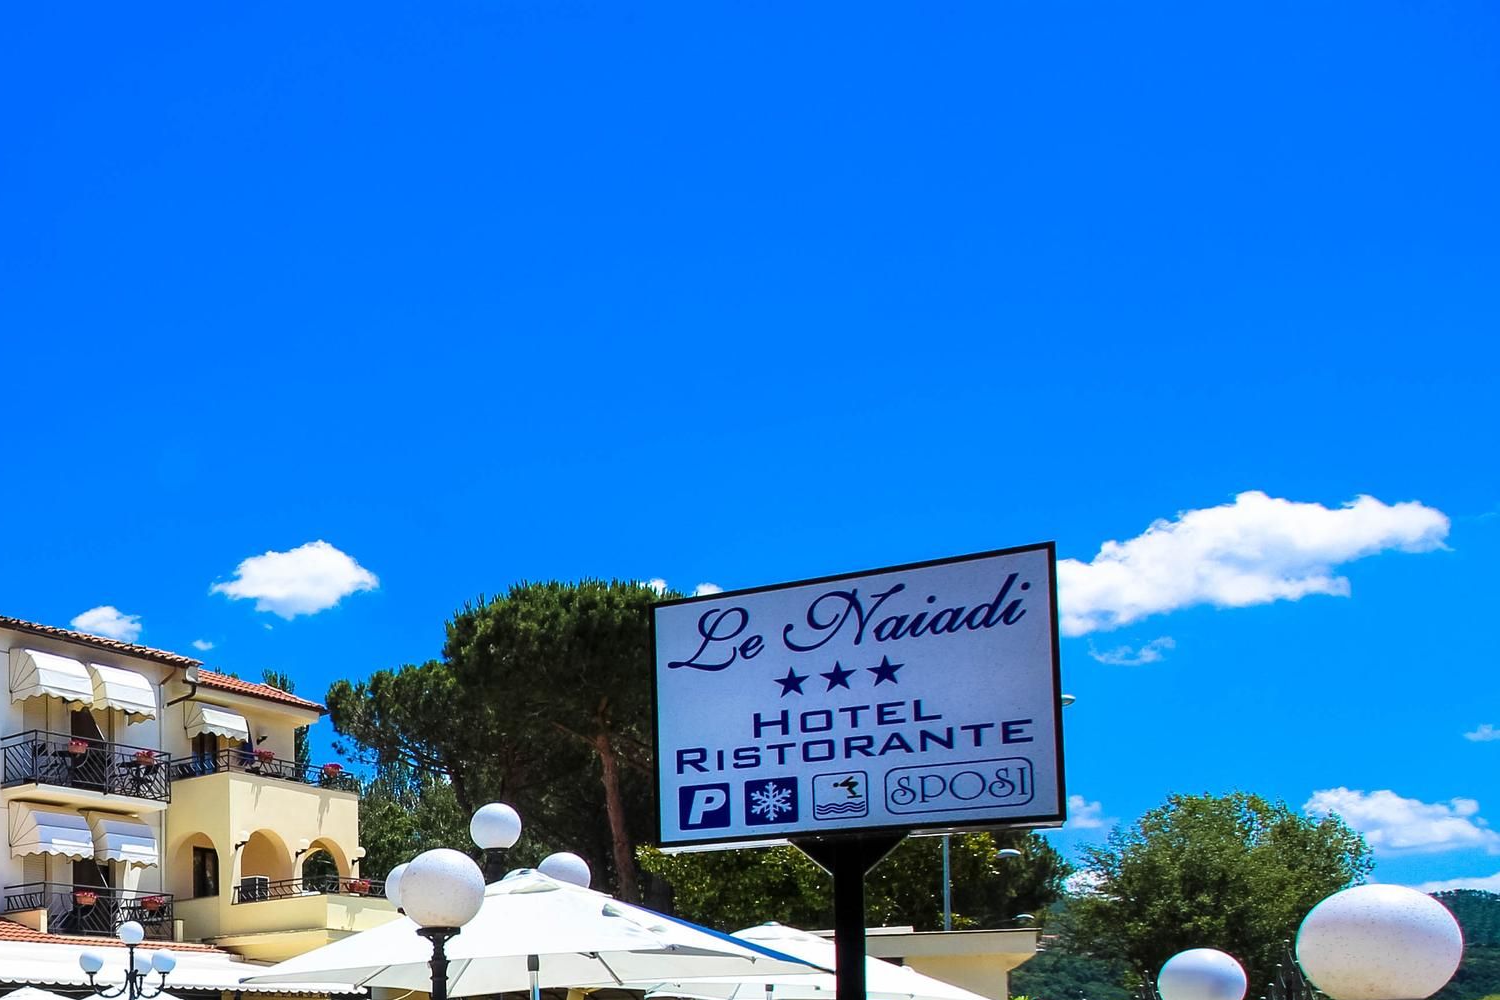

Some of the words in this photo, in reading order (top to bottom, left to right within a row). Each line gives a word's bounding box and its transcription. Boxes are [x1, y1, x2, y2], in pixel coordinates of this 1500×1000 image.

[667, 607, 765, 672] Le
[782, 572, 1031, 652] Naiadi
[753, 699, 942, 738] HOTEL
[676, 718, 1034, 774] RISTORANTE
[688, 788, 727, 824] P
[890, 766, 1029, 806] SPOSI
